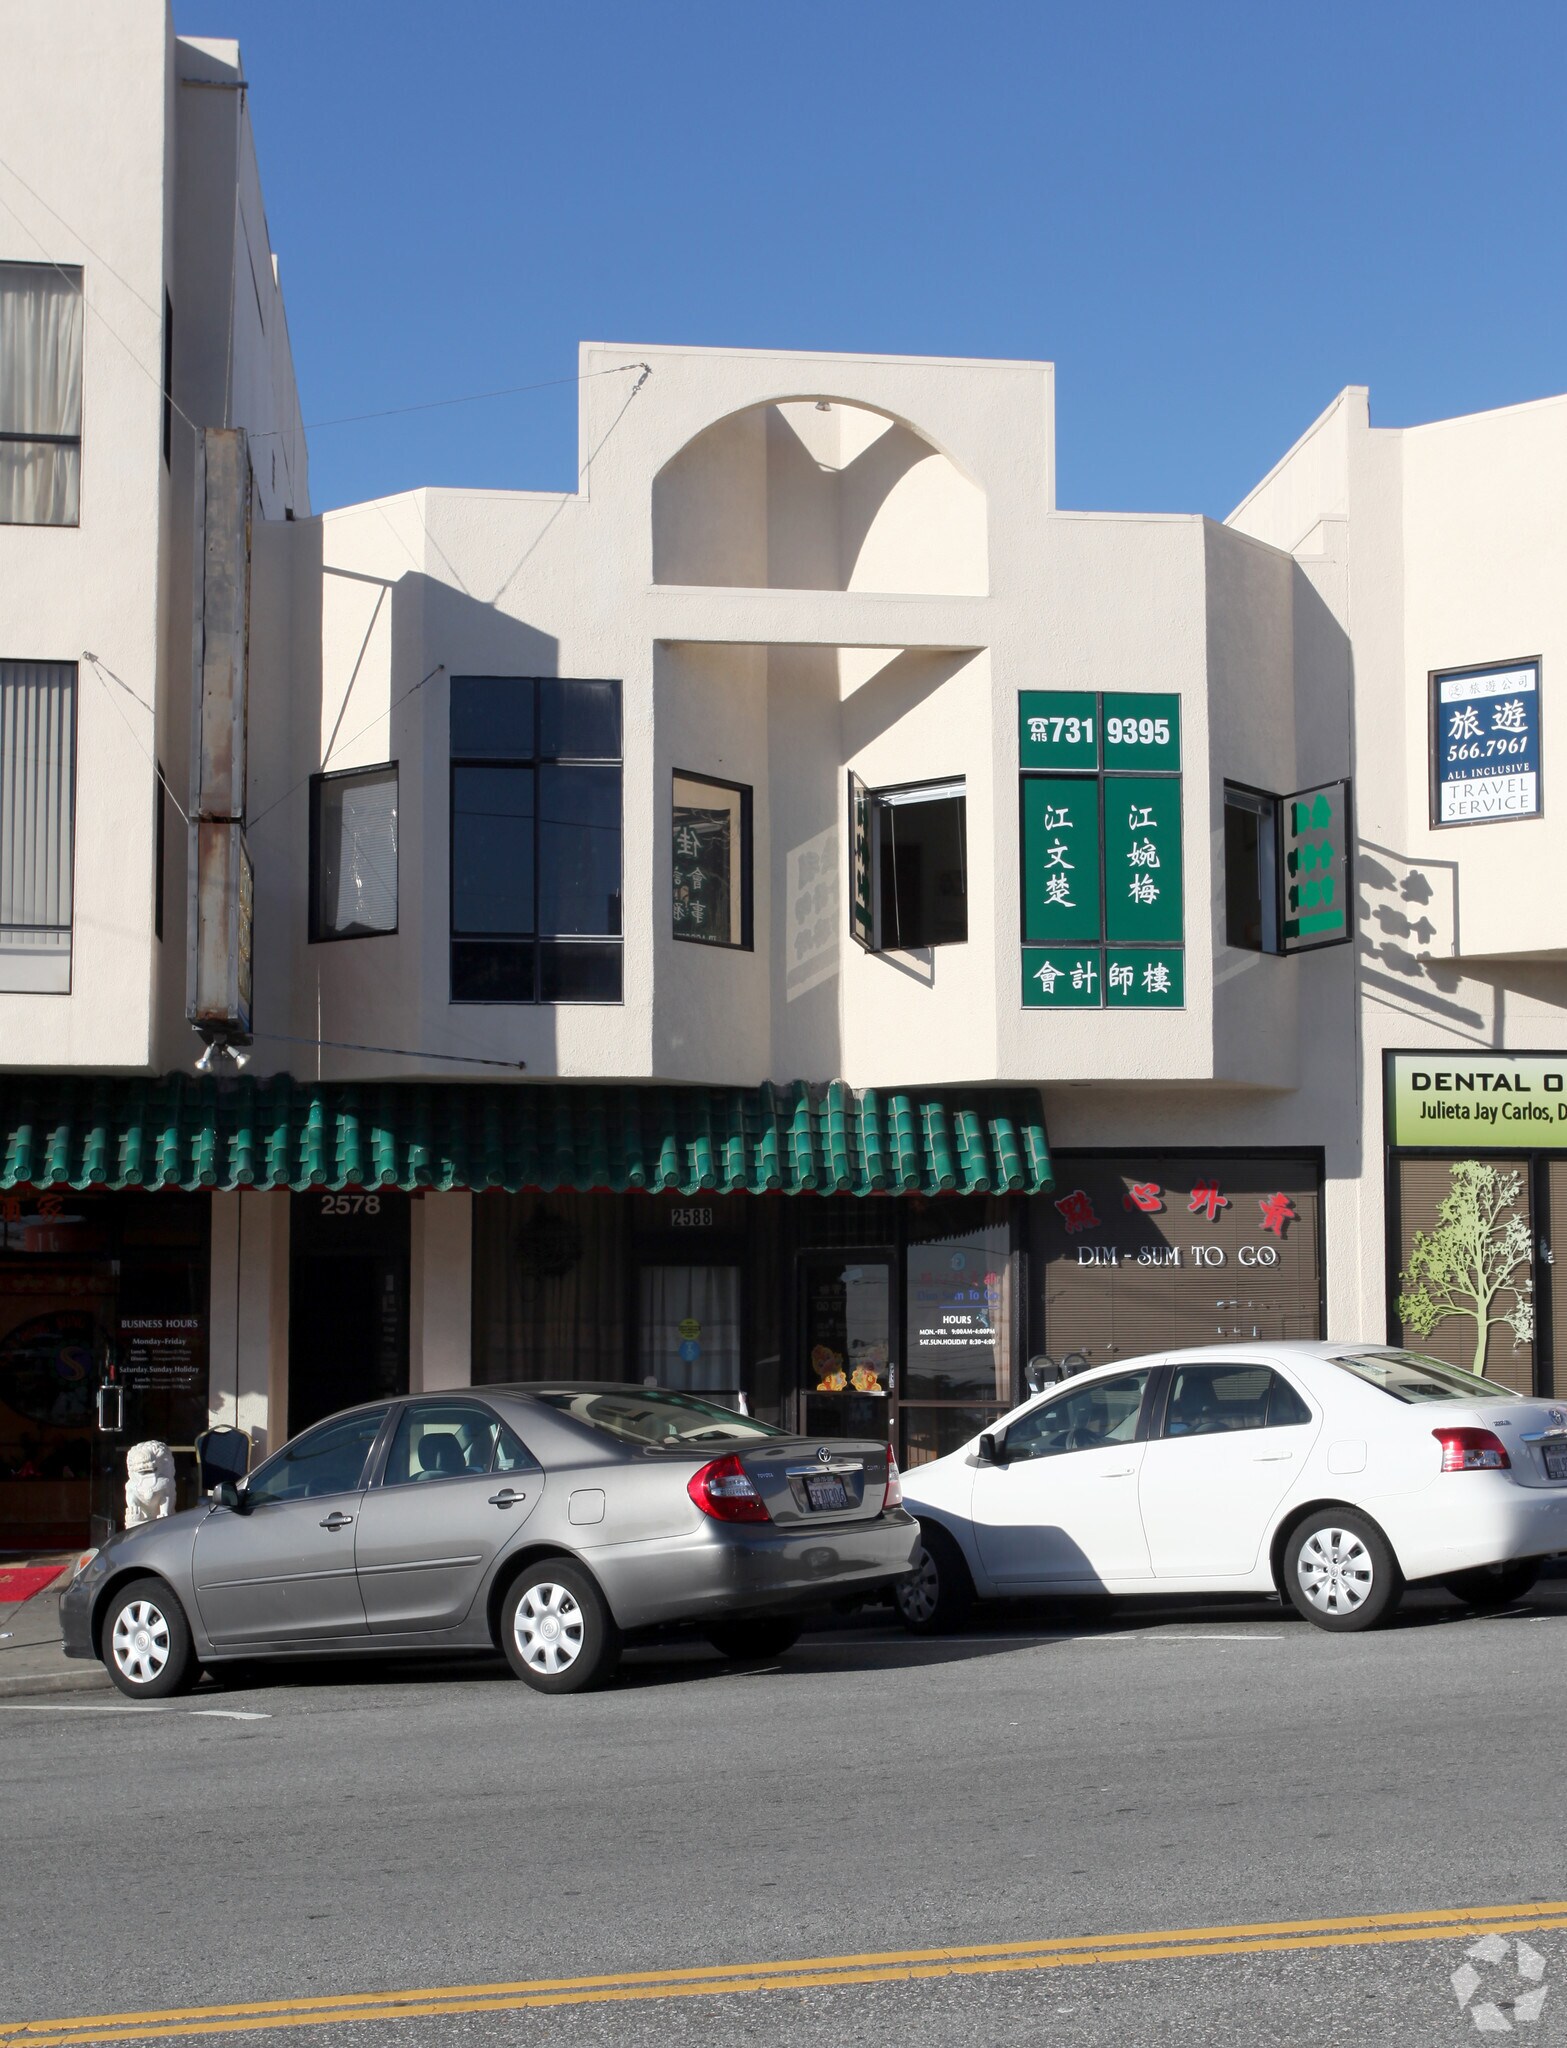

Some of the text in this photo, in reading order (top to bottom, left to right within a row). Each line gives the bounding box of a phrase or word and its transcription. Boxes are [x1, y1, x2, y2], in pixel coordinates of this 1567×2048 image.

[1448, 699, 1529, 740] 旅遊
[1030, 717, 1170, 745] 415 731 9395
[1447, 736, 1528, 762] 566.7961
[1447, 762, 1530, 781] ALL INCLUSIVE
[1449, 778, 1529, 799] TRAVEL
[1448, 794, 1529, 816] SERVICE
[1044, 805, 1076, 907] 江文楚
[1411, 1072, 1563, 1092] DENTAL O
[1420, 1100, 1470, 1120] Julieta
[1473, 1102, 1498, 1125] Jay
[1502, 1101, 1554, 1123] Carlos,
[320, 1195, 381, 1216] 2578
[673, 1209, 711, 1225] 2588
[1077, 1245, 1117, 1266] DIM
[1137, 1245, 1180, 1266] SUM
[1191, 1245, 1224, 1266] TO
[1238, 1245, 1276, 1266] GO
[121, 1319, 198, 1329] BUSINESS HOURS
[942, 1315, 972, 1324] HOURS
